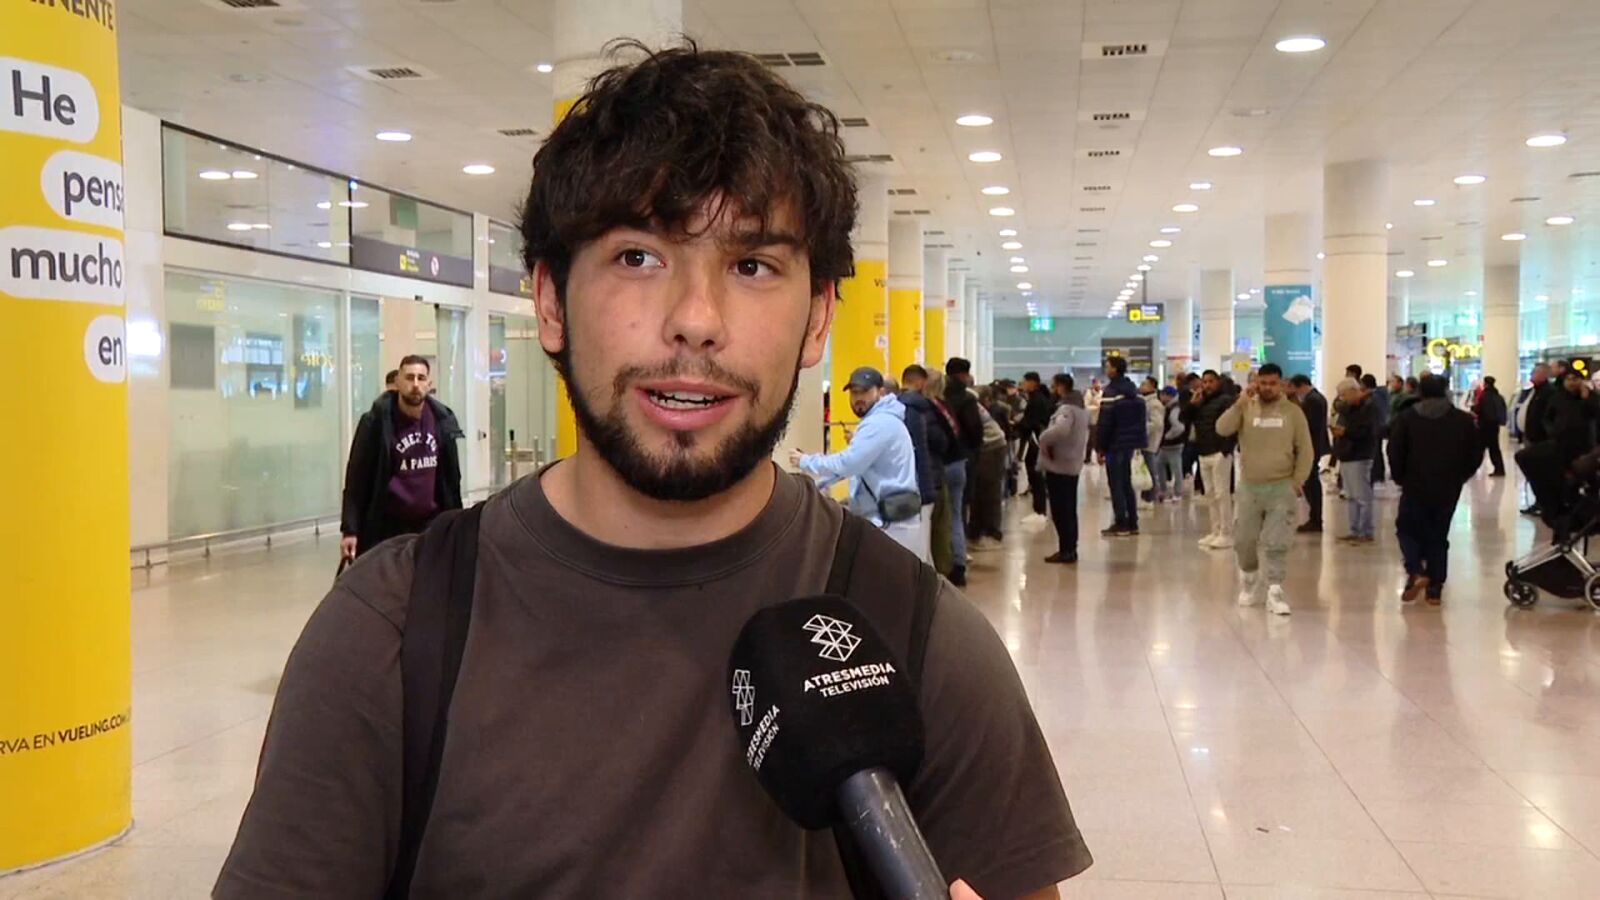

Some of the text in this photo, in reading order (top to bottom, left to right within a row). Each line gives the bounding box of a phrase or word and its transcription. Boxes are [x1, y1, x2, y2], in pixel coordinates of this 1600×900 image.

[12, 69, 76, 125] He
[11, 242, 122, 288] mucho
[98, 335, 122, 366] en
[396, 432, 422, 453] CHEZ
[400, 455, 438, 470] A PARIS
[804, 662, 896, 692] ATRESMEDIA
[820, 674, 890, 698] TELEVISIÓN
[33, 732, 56, 750] EN
